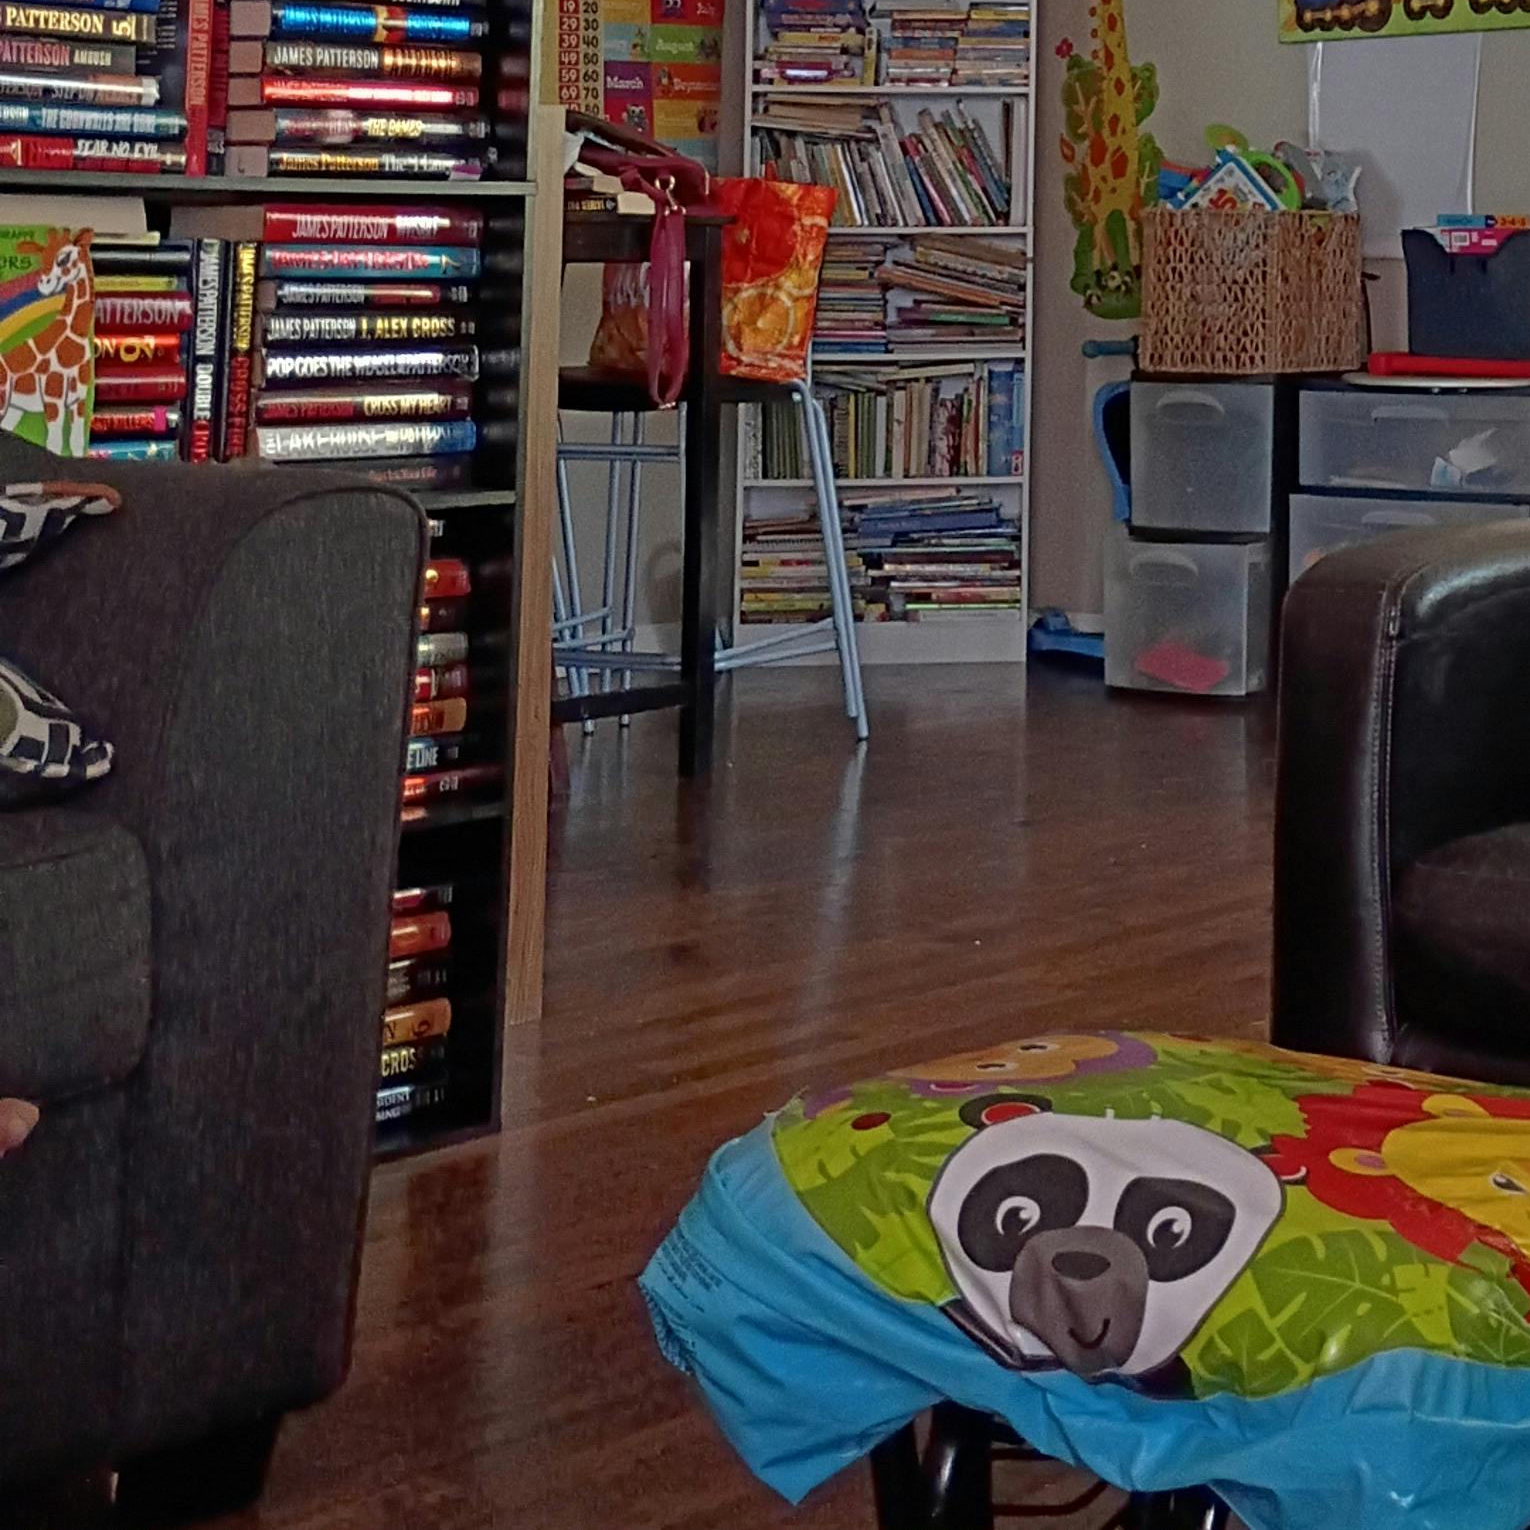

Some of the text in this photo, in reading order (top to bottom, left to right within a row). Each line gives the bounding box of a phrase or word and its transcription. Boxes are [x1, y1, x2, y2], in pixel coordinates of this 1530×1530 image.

[563, 0, 599, 14] 19 20
[5, 6, 105, 34] PATTERSON
[562, 17, 599, 31] 29 30
[562, 34, 599, 48] 39 40
[655, 38, 696, 55] August
[274, 46, 313, 68] JAMES
[316, 48, 379, 69] PATTERSON
[561, 52, 599, 66] 49 50
[190, 33, 210, 106] PATTERSON
[562, 69, 599, 83] 59 60
[561, 85, 599, 100] 69 70
[606, 75, 644, 90] March
[76, 138, 160, 159] FEAR NO EVIL
[279, 152, 319, 171] James
[320, 151, 380, 171] Patterson
[292, 212, 329, 239] JAMES
[330, 215, 389, 239] PATTERSON
[238, 242, 258, 281] JAMES
[314, 284, 366, 304] PATTERSON
[94, 298, 179, 325] ATTERSON
[233, 282, 255, 352] PATTERSON
[193, 238, 220, 421] JAMES PATTERSON DOUBLE
[267, 316, 456, 340] JAMES PATTERSON ALEX CROSS
[267, 356, 295, 377] POP
[295, 355, 329, 378] GOES
[330, 355, 354, 378] THE
[363, 395, 399, 418] CROSS
[399, 394, 418, 416] MY
[418, 393, 453, 416] HEART
[415, 746, 439, 768] LINE
[381, 1047, 417, 1078] CROS
